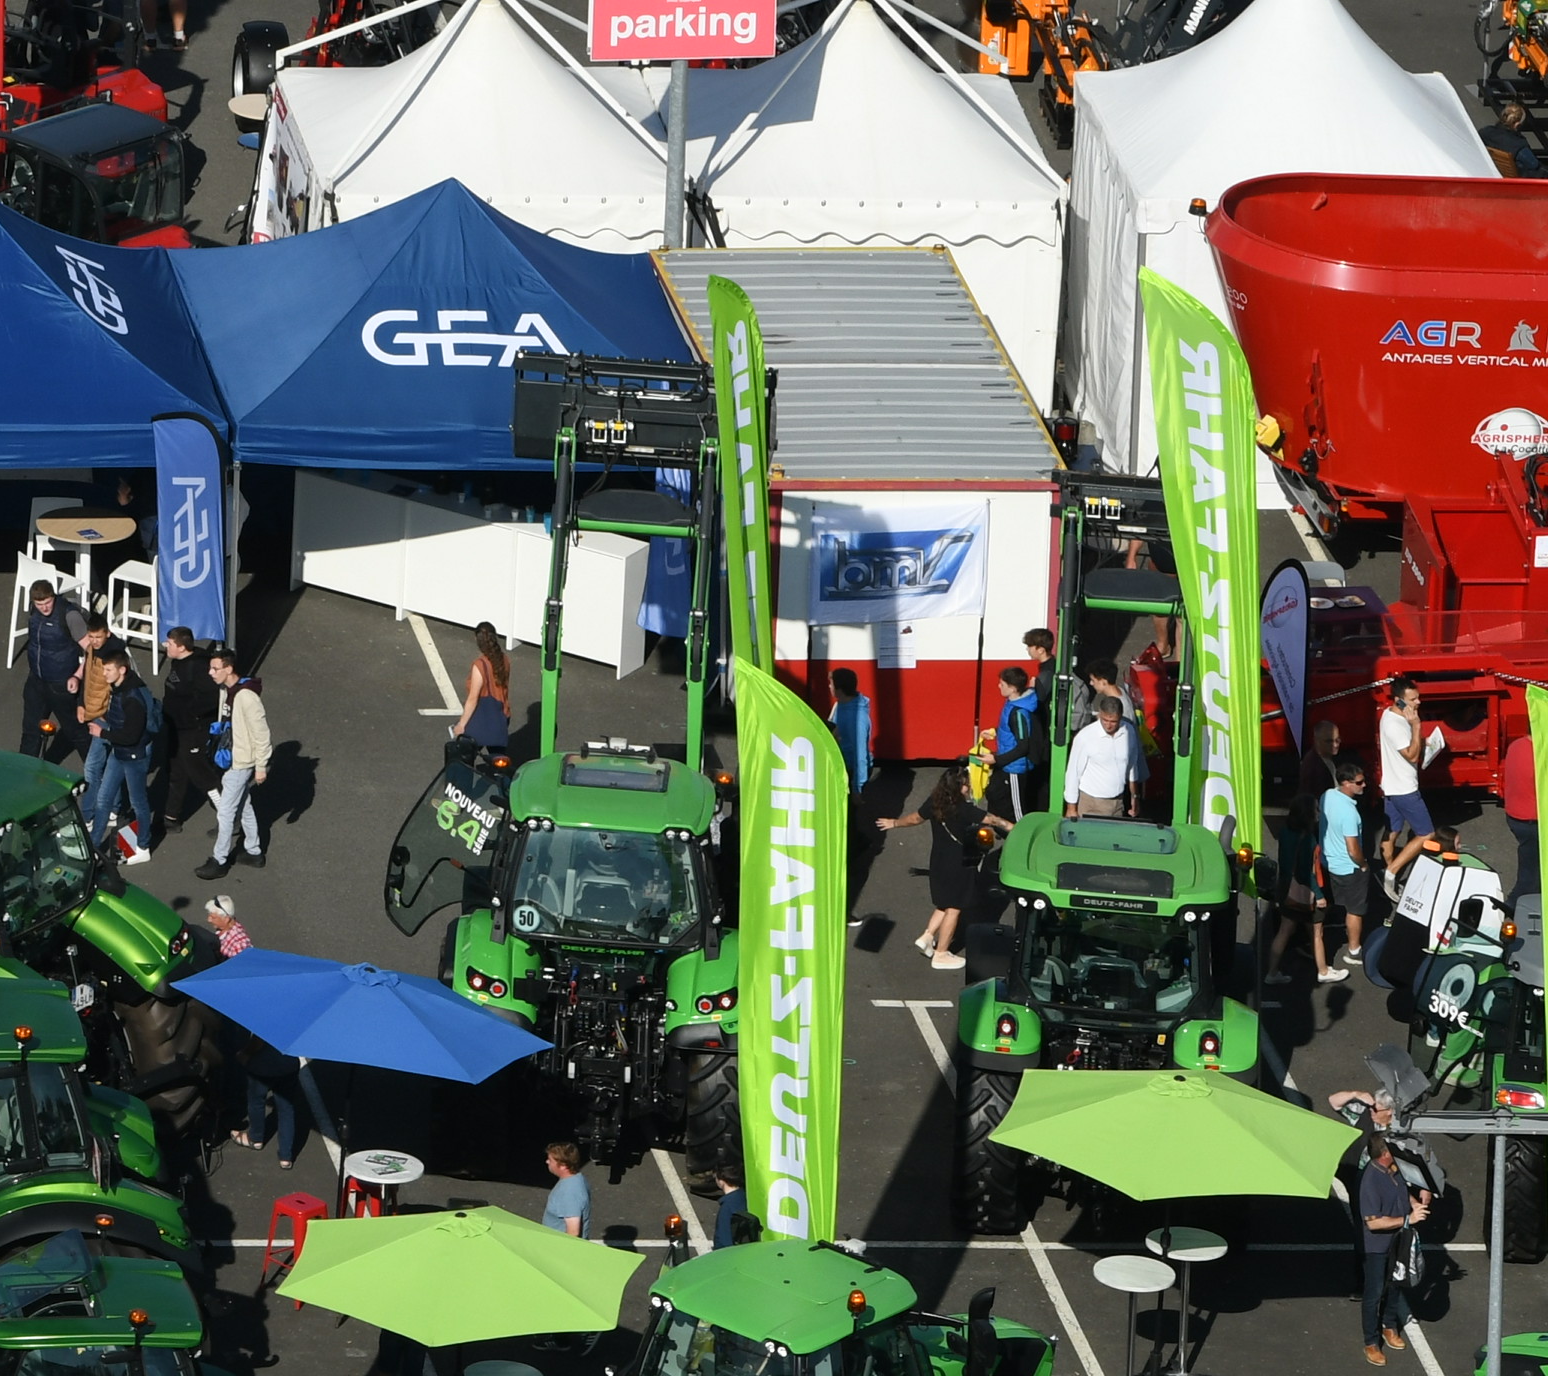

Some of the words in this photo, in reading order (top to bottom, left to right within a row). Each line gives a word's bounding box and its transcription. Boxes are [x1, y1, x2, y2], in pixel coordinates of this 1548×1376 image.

[610, 7, 757, 47] parking
[56, 244, 129, 335] GEA
[361, 309, 572, 367] GEA
[1379, 319, 1483, 348] AGR
[1382, 352, 1453, 365] ANTARES
[1457, 355, 1529, 367] VERTICAL
[444, 782, 497, 829] NOUVEAU
[1083, 897, 1144, 909] DEUTZ-FAHR
[1405, 895, 1424, 909] DEUTZ
[518, 910, 535, 928] 50
[560, 943, 645, 957] DEUTZ-FAHR
[1429, 994, 1469, 1026] 309€
